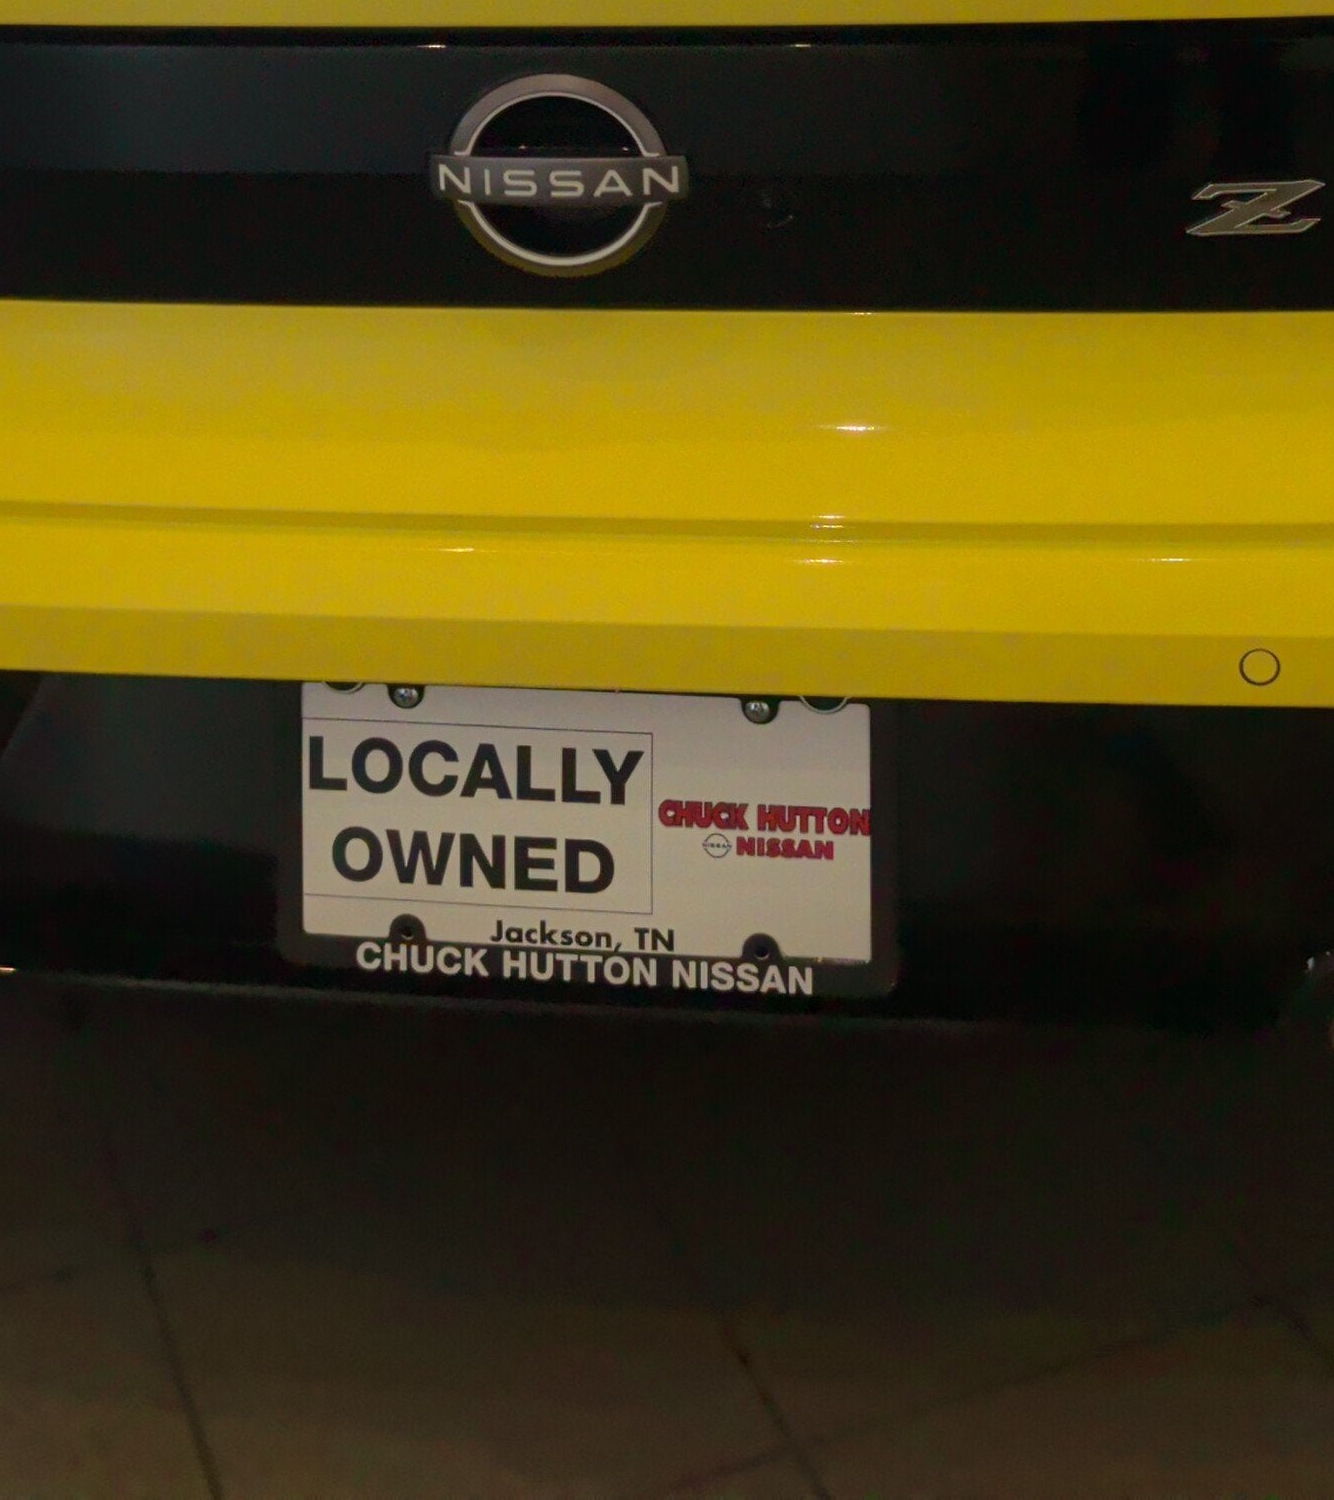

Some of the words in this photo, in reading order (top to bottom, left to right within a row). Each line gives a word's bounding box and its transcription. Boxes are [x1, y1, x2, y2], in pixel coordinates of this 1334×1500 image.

[438, 163, 679, 198] NISSAN
[1185, 178, 1327, 237] Z
[308, 736, 644, 805] LOCALLY
[658, 799, 749, 831] CHUCK
[757, 804, 870, 836] HUTTON
[331, 825, 615, 895] OWNED
[736, 836, 834, 861] NISSAN
[489, 918, 622, 954] Jackson,
[633, 927, 675, 953] TN
[355, 941, 488, 978] CHUCK
[503, 950, 658, 989] HUTTON
[672, 960, 814, 996] NISSAN
